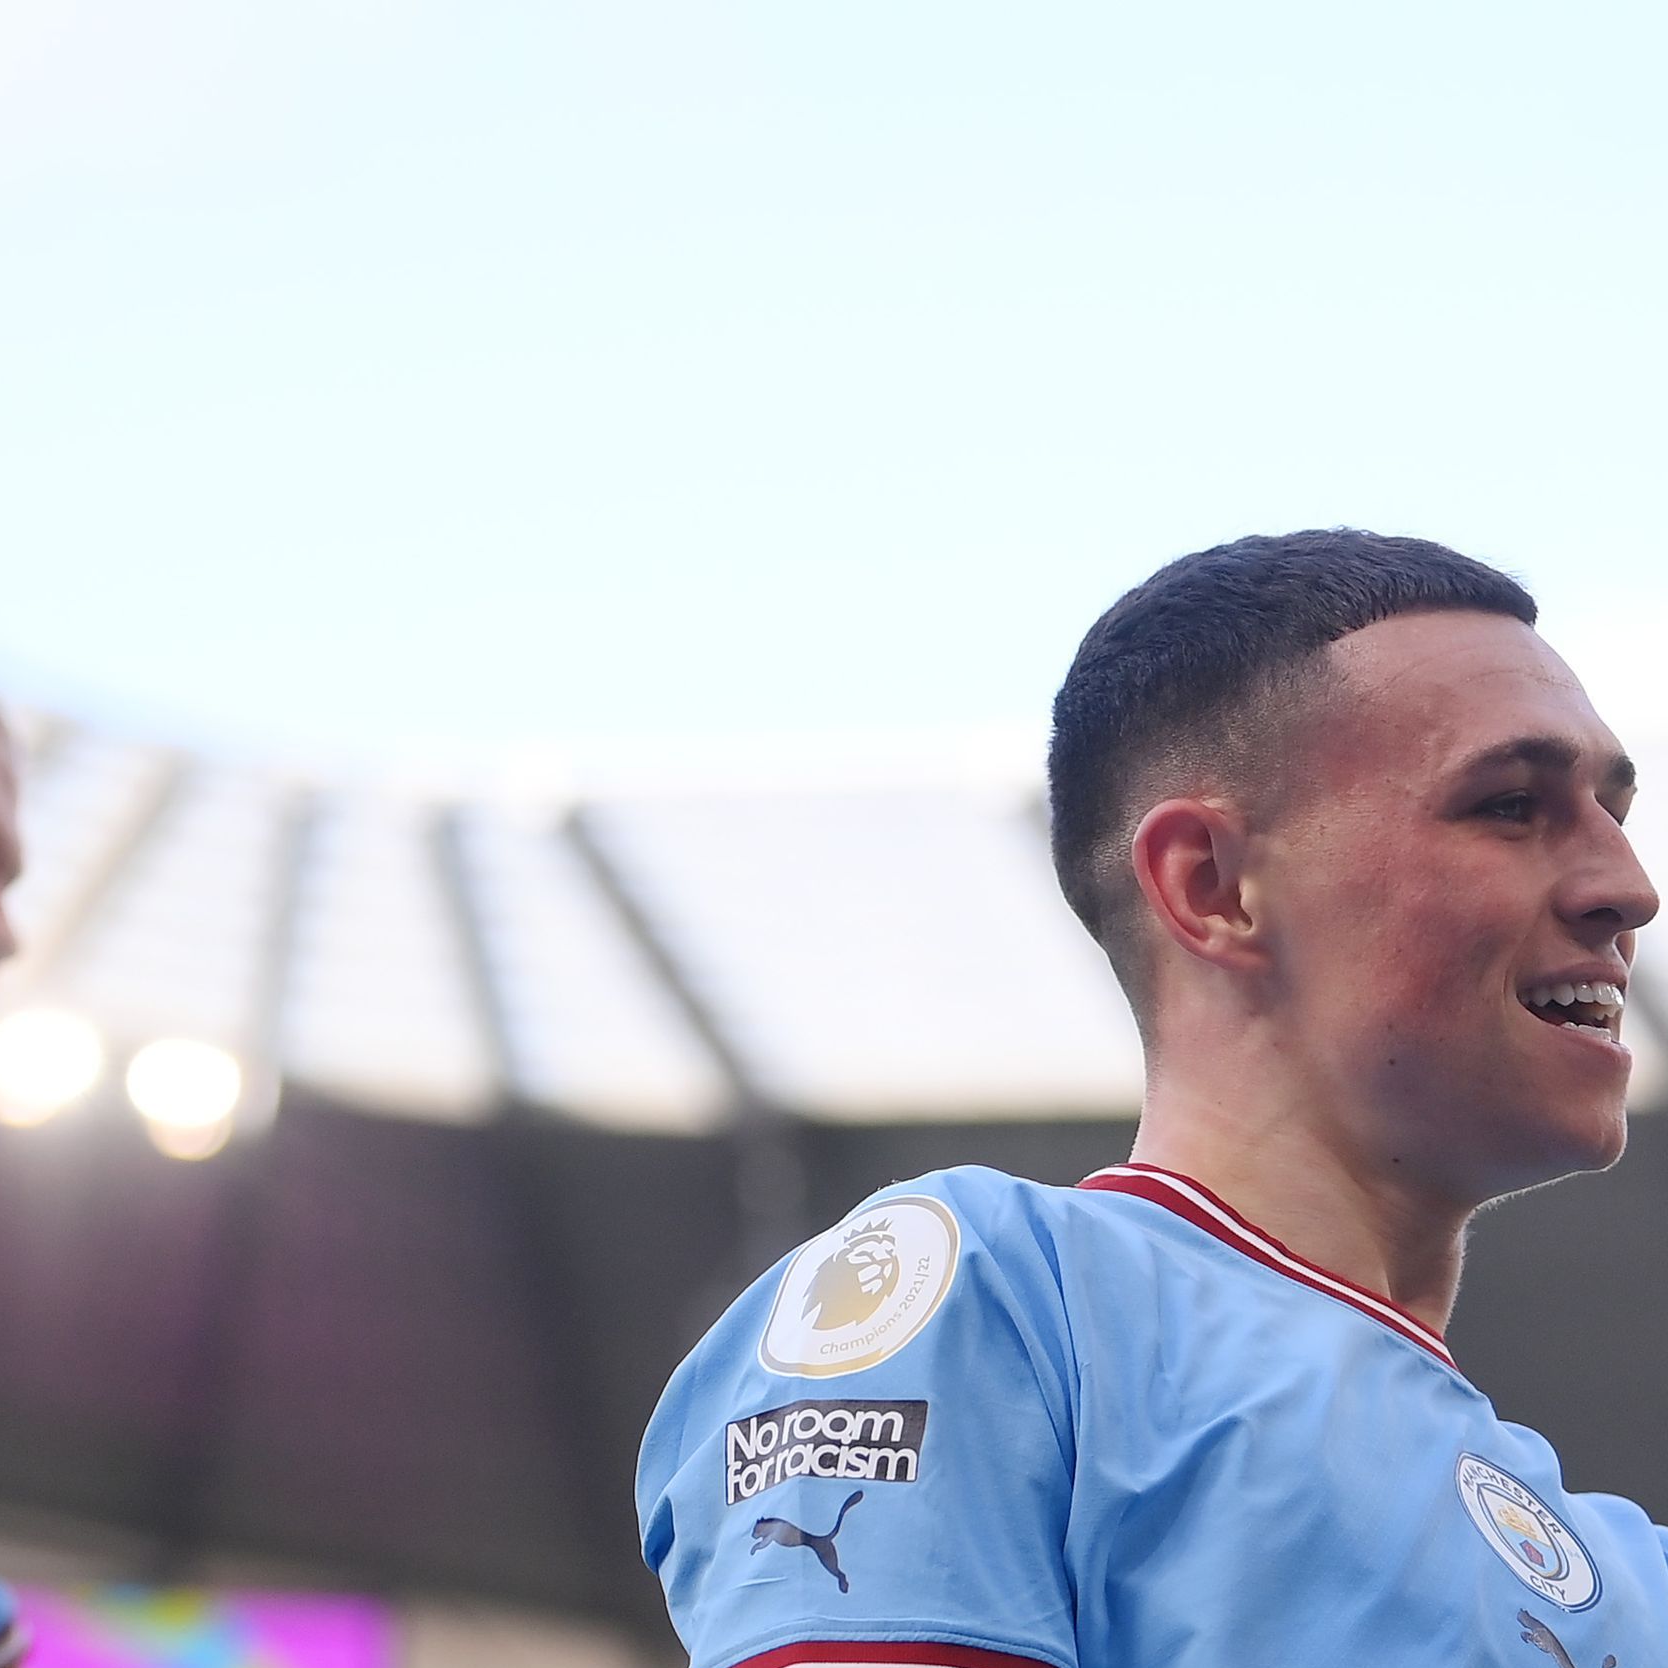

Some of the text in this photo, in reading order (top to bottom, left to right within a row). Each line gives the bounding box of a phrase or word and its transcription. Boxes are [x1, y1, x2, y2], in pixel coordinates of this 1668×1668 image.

[820, 1311, 902, 1355] Champions
[727, 1408, 904, 1466] No room
[774, 1443, 918, 1484] racism
[1463, 1465, 1561, 1534] MANCHESTER
[1529, 1575, 1566, 1601] CITY
